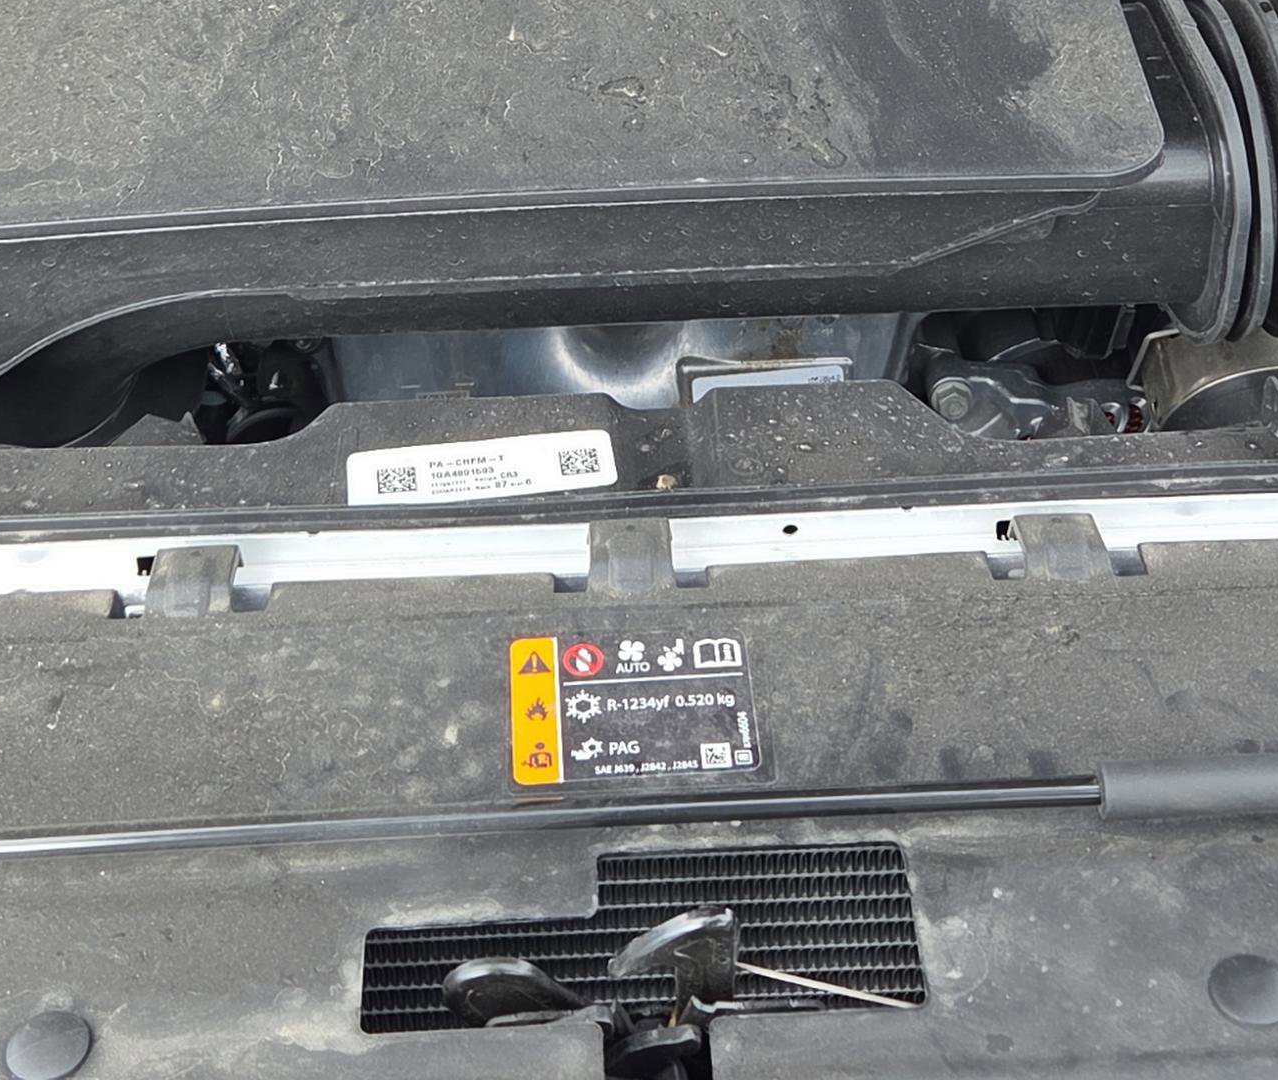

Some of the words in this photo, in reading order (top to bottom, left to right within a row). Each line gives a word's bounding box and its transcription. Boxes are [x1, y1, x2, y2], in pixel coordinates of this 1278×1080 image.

[615, 661, 651, 674] AUTO
[607, 694, 670, 711] R-1234yf
[675, 693, 714, 707] 0.520
[717, 692, 735, 707] kg
[609, 740, 640, 755] PAG
[594, 765, 612, 775] SAE
